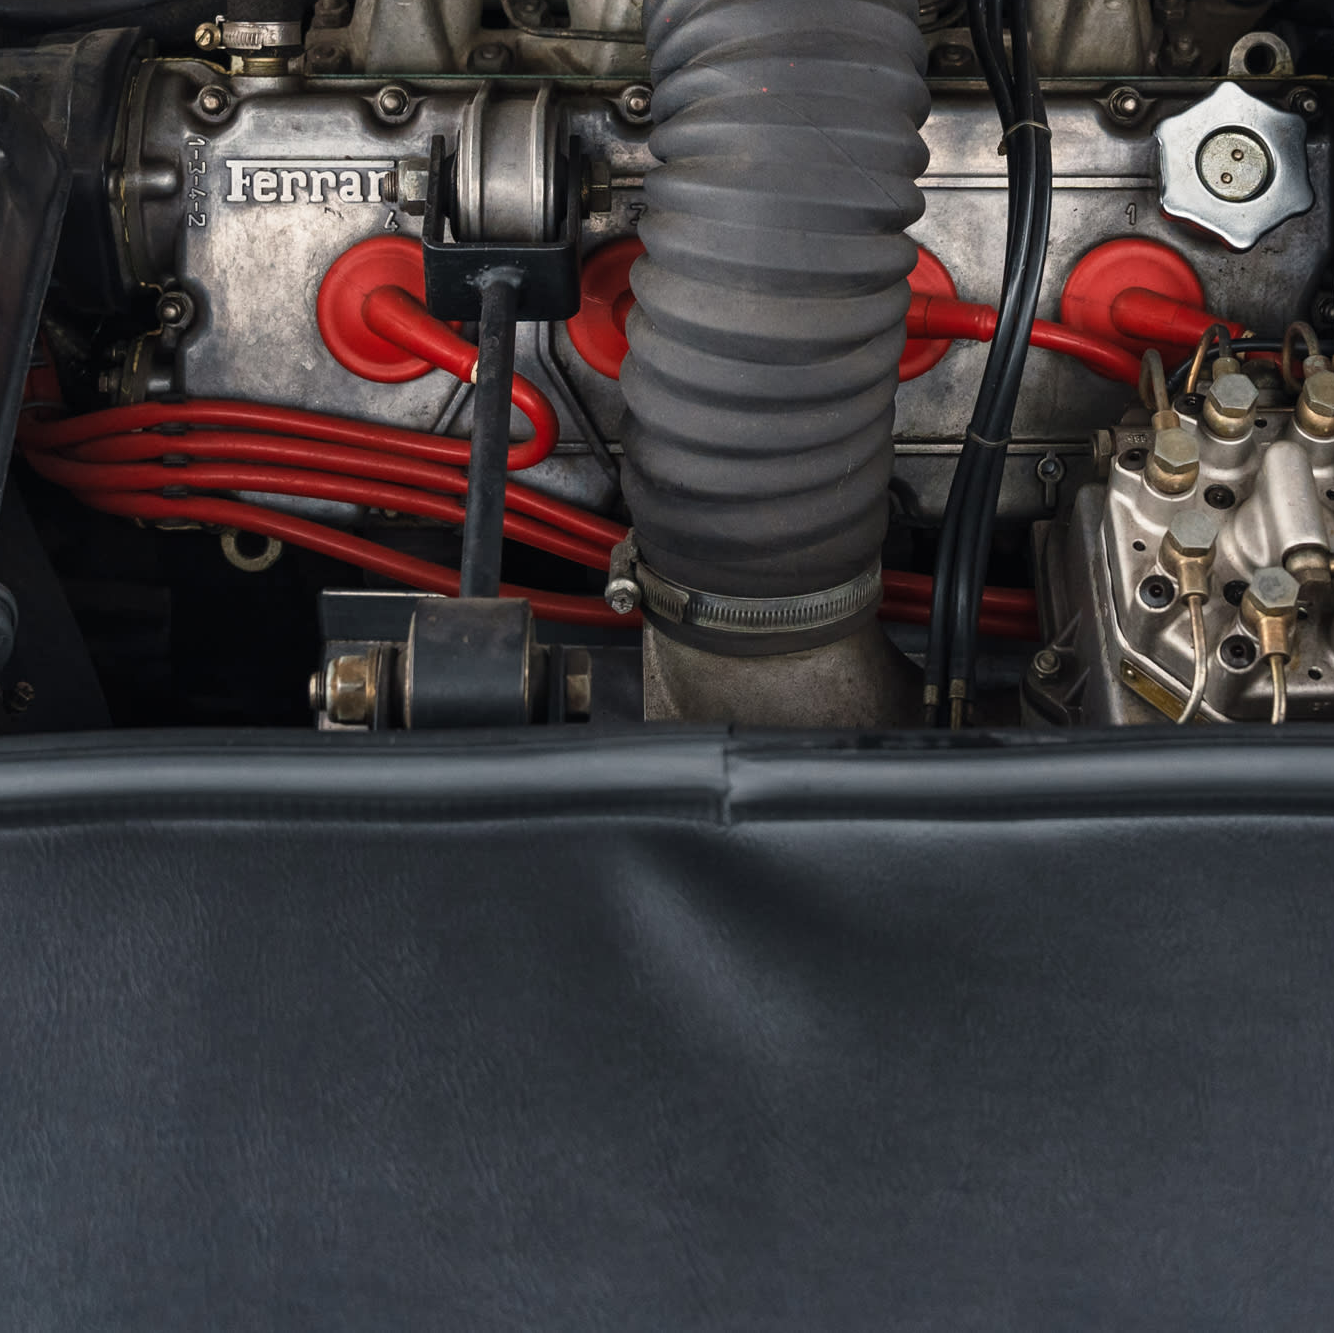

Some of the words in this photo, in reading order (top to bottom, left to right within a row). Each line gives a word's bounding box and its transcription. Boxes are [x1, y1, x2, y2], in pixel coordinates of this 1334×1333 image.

[188, 138, 206, 227] 1-3-4-2
[226, 160, 400, 203] Ferrar
[384, 210, 399, 231] 4
[1125, 203, 1136, 225] 1
